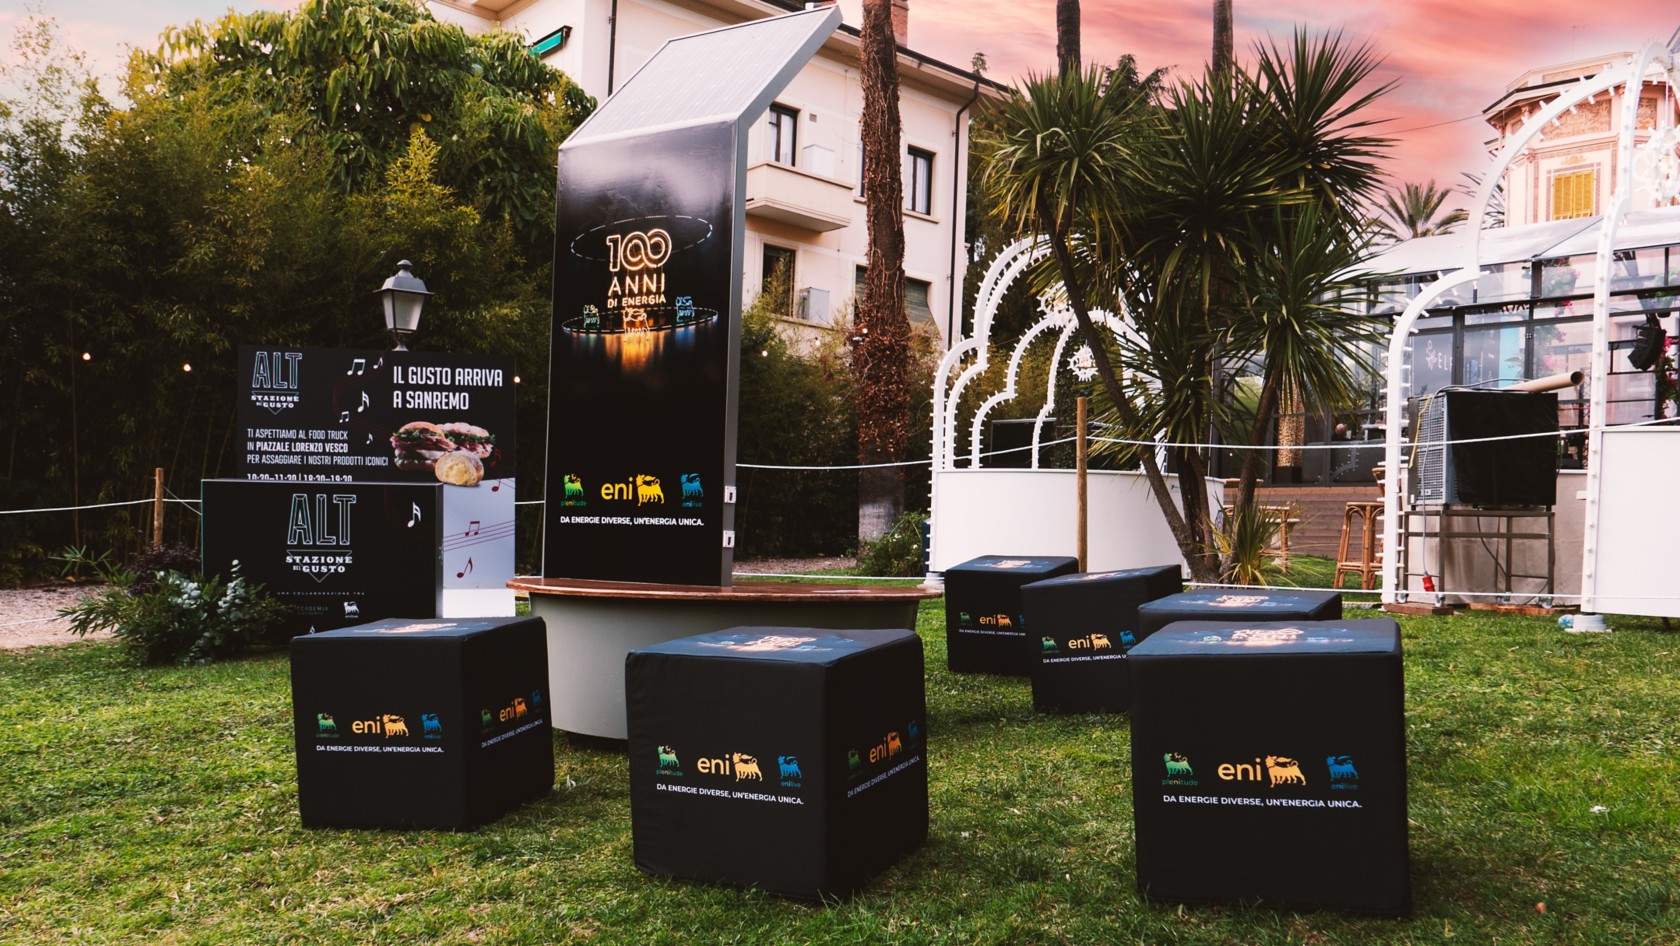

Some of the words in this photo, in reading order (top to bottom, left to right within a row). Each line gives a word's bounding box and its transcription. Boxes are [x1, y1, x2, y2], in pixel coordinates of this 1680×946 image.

[606, 228, 672, 272] 100
[608, 273, 665, 296] ANNI
[608, 299, 618, 308] DI
[622, 294, 666, 306] ENERGIA
[252, 351, 303, 390] ALT
[393, 366, 404, 384] IL
[408, 366, 451, 385] GUSTO
[455, 368, 503, 387] ARRIVA
[393, 390, 402, 408] A
[406, 391, 469, 410] SANREMO
[247, 428, 254, 438] TI
[255, 429, 296, 439] ASPETTIAMO
[298, 430, 307, 439] AL
[308, 430, 326, 440] FOOD
[328, 430, 348, 440] TRUCK
[247, 442, 254, 451] IN
[256, 442, 289, 452] PIAZZALE
[291, 443, 323, 452] LORENZO
[325, 443, 348, 453] VESCO
[247, 454, 260, 464] PER
[262, 455, 302, 465] ASSAGGIARE
[304, 456, 306, 464] I
[308, 456, 331, 465] NOSTRI
[333, 456, 364, 466] PRODOTTI
[365, 457, 389, 466] ICONICI
[601, 477, 633, 500] eni
[287, 494, 356, 545] ALT
[601, 517, 632, 525] DIVERSE,
[979, 614, 996, 625] eni
[1068, 635, 1090, 649] eni
[500, 702, 514, 722] eni
[352, 716, 380, 734] eni
[869, 736, 887, 763] eni
[697, 754, 730, 775] eni
[1218, 757, 1262, 781] eni
[1161, 778, 1198, 787] plenitude
[668, 784, 698, 794] ENERGIE
[699, 788, 731, 798] DIVERSE,
[732, 791, 776, 802] UN'ENERGIA
[778, 796, 804, 805] UNICA.
[847, 790, 854, 798] DA
[1179, 795, 1219, 804] ENERGIE
[1221, 797, 1264, 807] DIVERSE,
[1266, 798, 1326, 807] UN'ENERGIA
[1328, 799, 1362, 808] UNICA.
